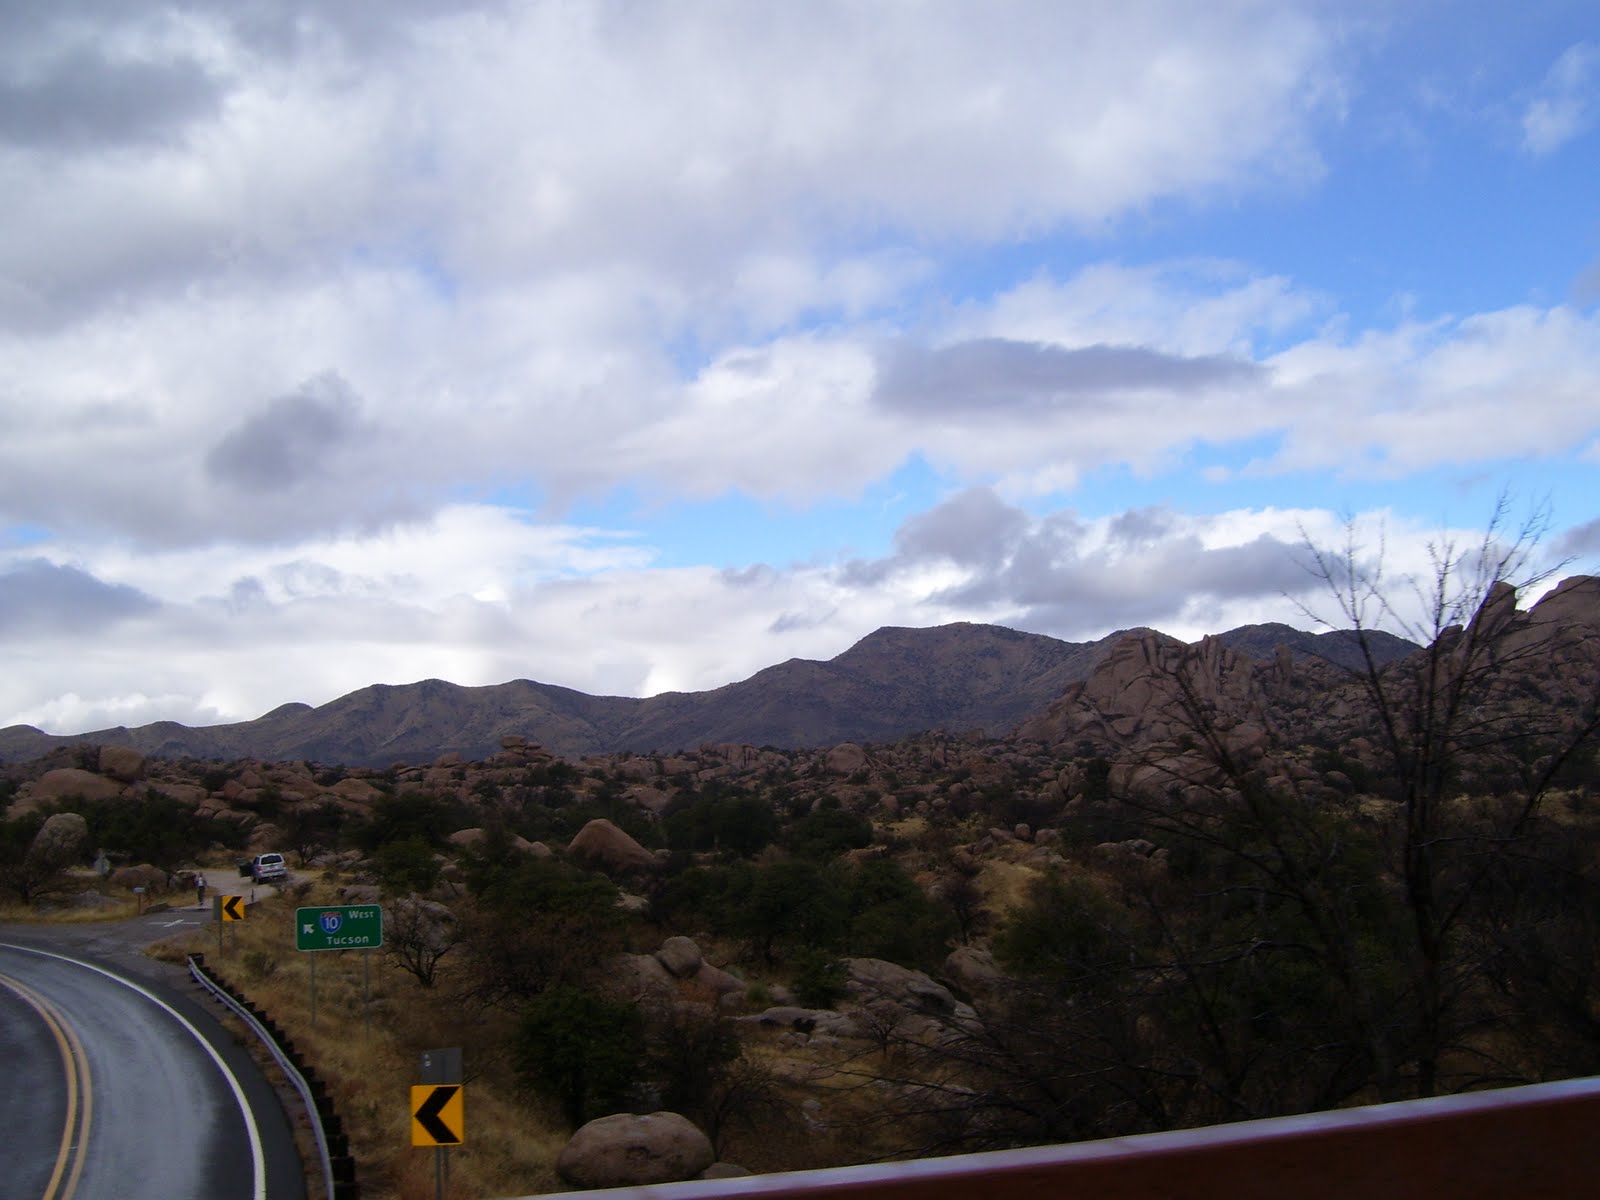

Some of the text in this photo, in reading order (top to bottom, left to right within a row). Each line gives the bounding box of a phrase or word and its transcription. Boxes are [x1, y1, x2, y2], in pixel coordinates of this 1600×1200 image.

[325, 917, 338, 929] 10
[348, 910, 374, 919] WEST
[326, 936, 369, 945] Tucson
